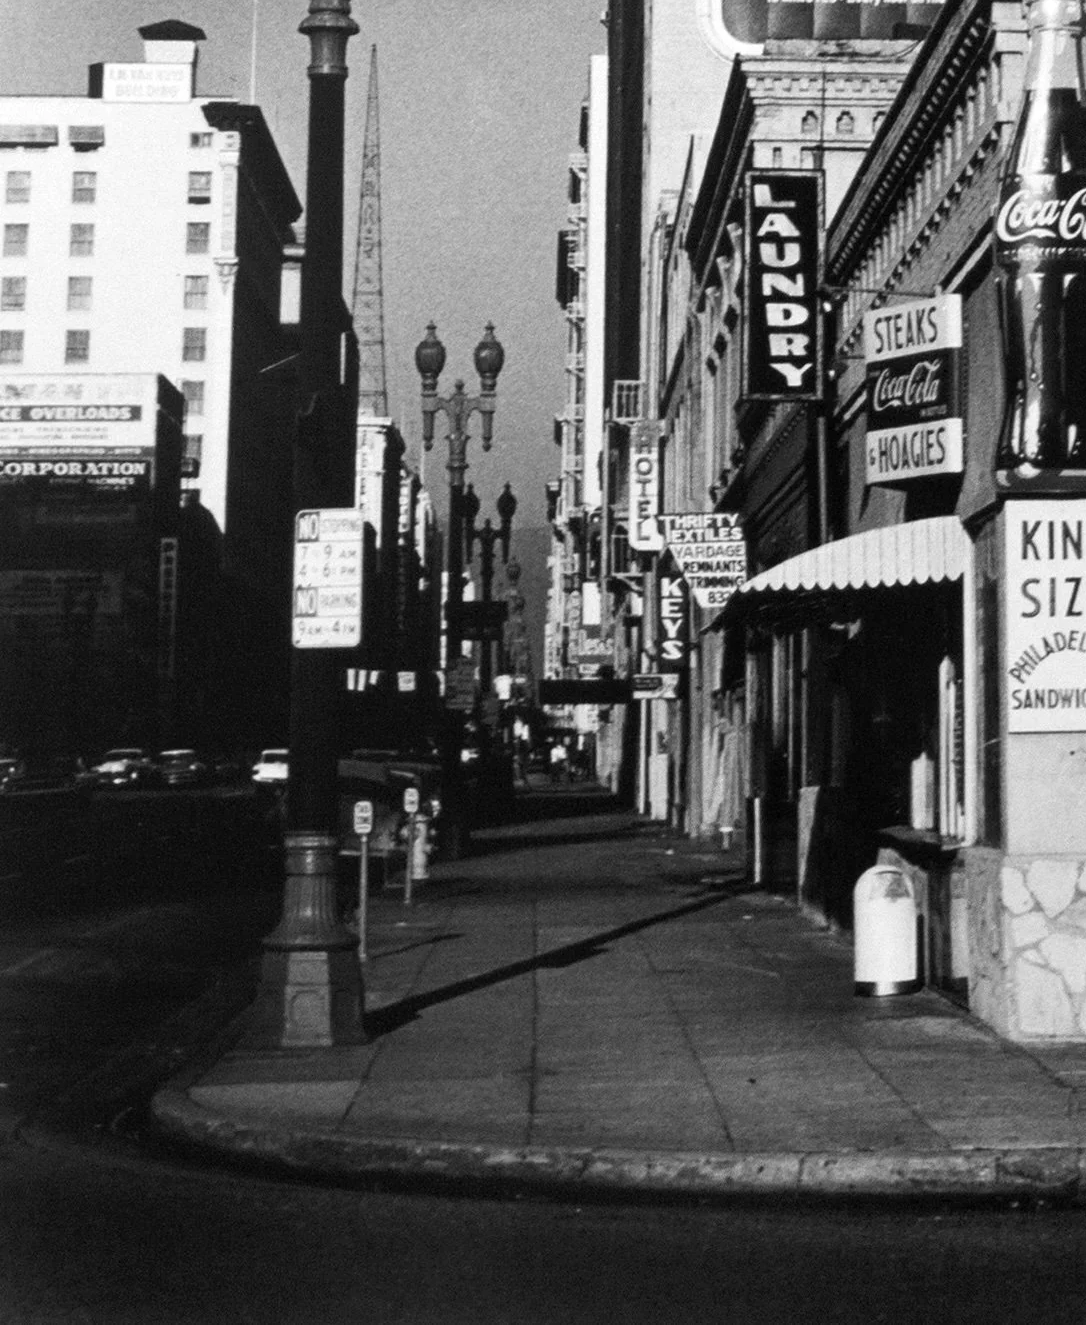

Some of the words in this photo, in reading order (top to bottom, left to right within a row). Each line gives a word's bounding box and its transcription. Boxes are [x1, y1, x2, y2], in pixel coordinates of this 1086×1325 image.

[753, 184, 813, 387] LAUNDRY
[874, 306, 938, 354] STEAKS
[873, 358, 942, 411] Coca-Cola
[29, 406, 132, 420] OVERLOADS
[878, 427, 945, 473] HOAGIES
[636, 438, 652, 541] HOTEL
[658, 513, 739, 528] THRIFTY
[674, 546, 743, 559] YARDAGE
[683, 560, 745, 573] REMNANTS
[661, 577, 683, 660] KEYS
